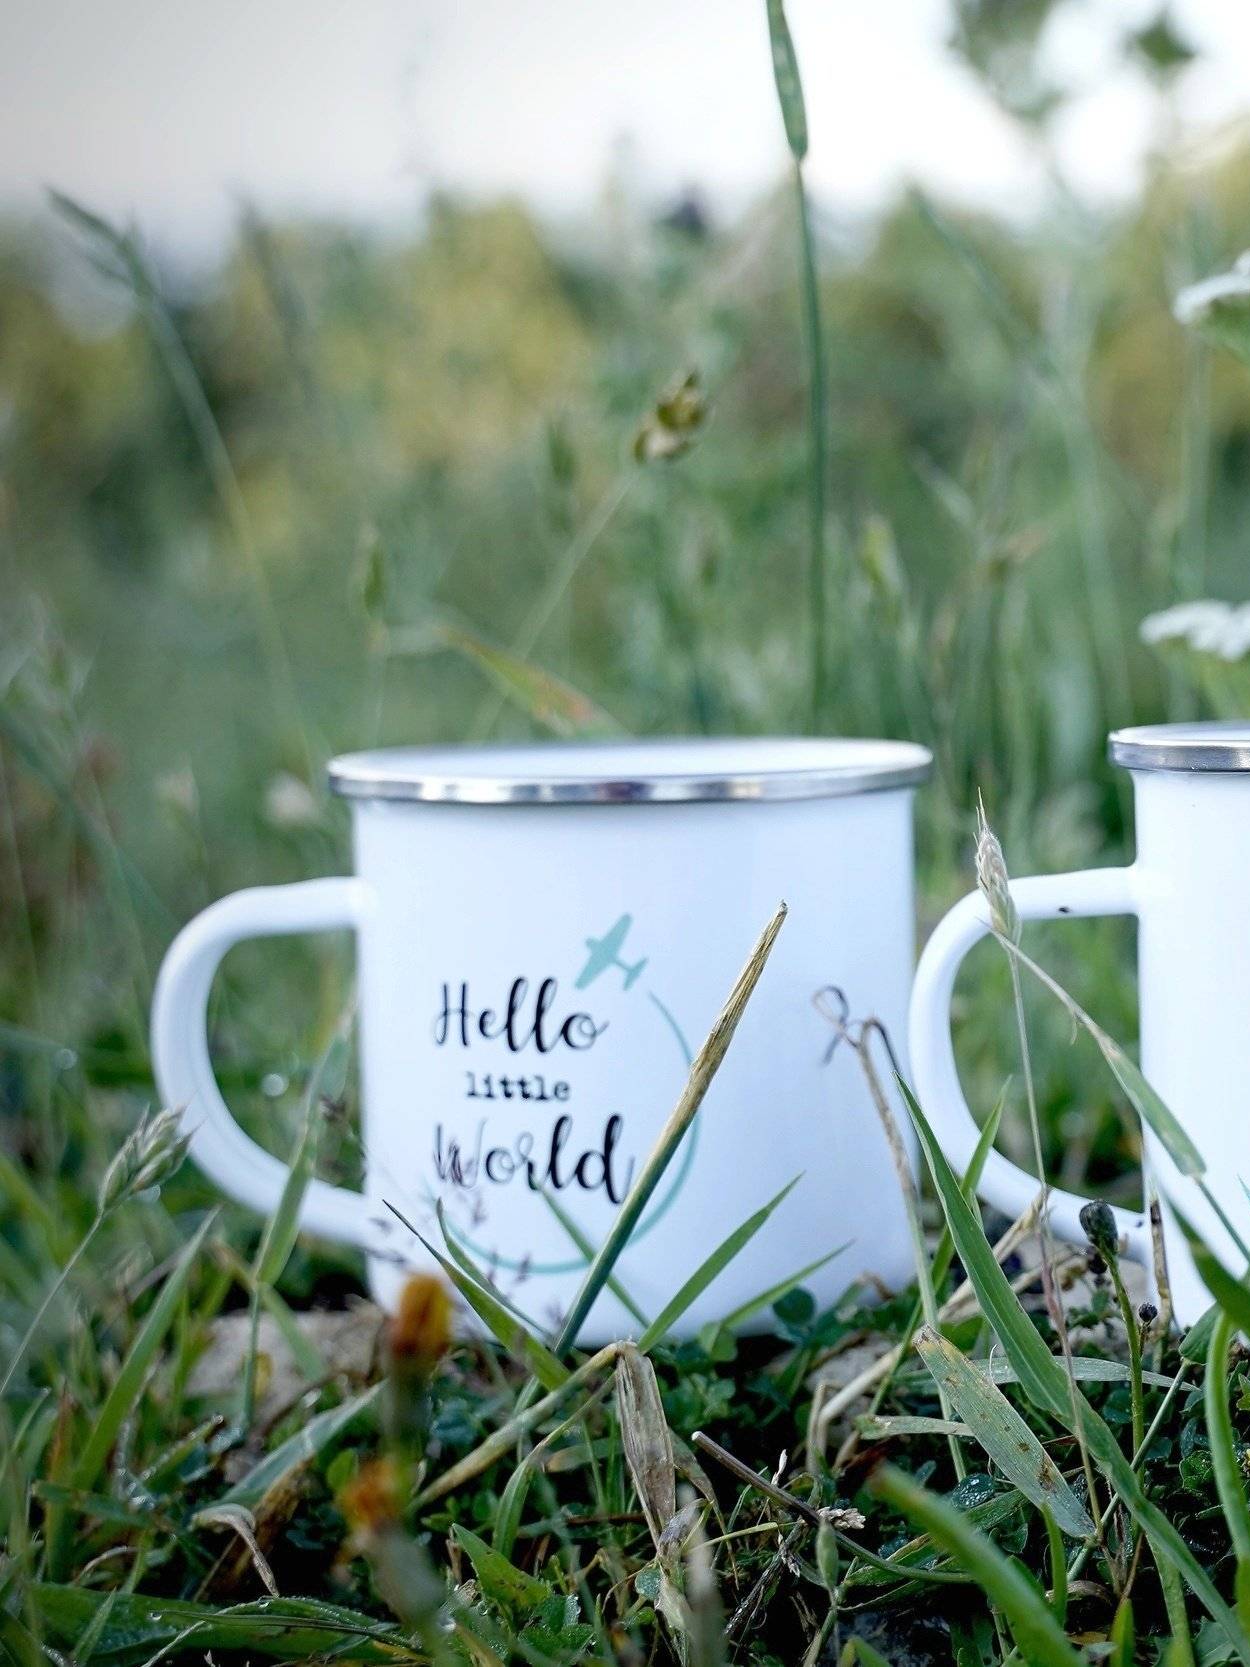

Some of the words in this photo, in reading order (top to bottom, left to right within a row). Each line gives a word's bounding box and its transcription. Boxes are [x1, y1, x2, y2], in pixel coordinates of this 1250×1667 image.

[434, 976, 610, 1053] Hello
[465, 1071, 571, 1101] little
[433, 1114, 635, 1205] World
